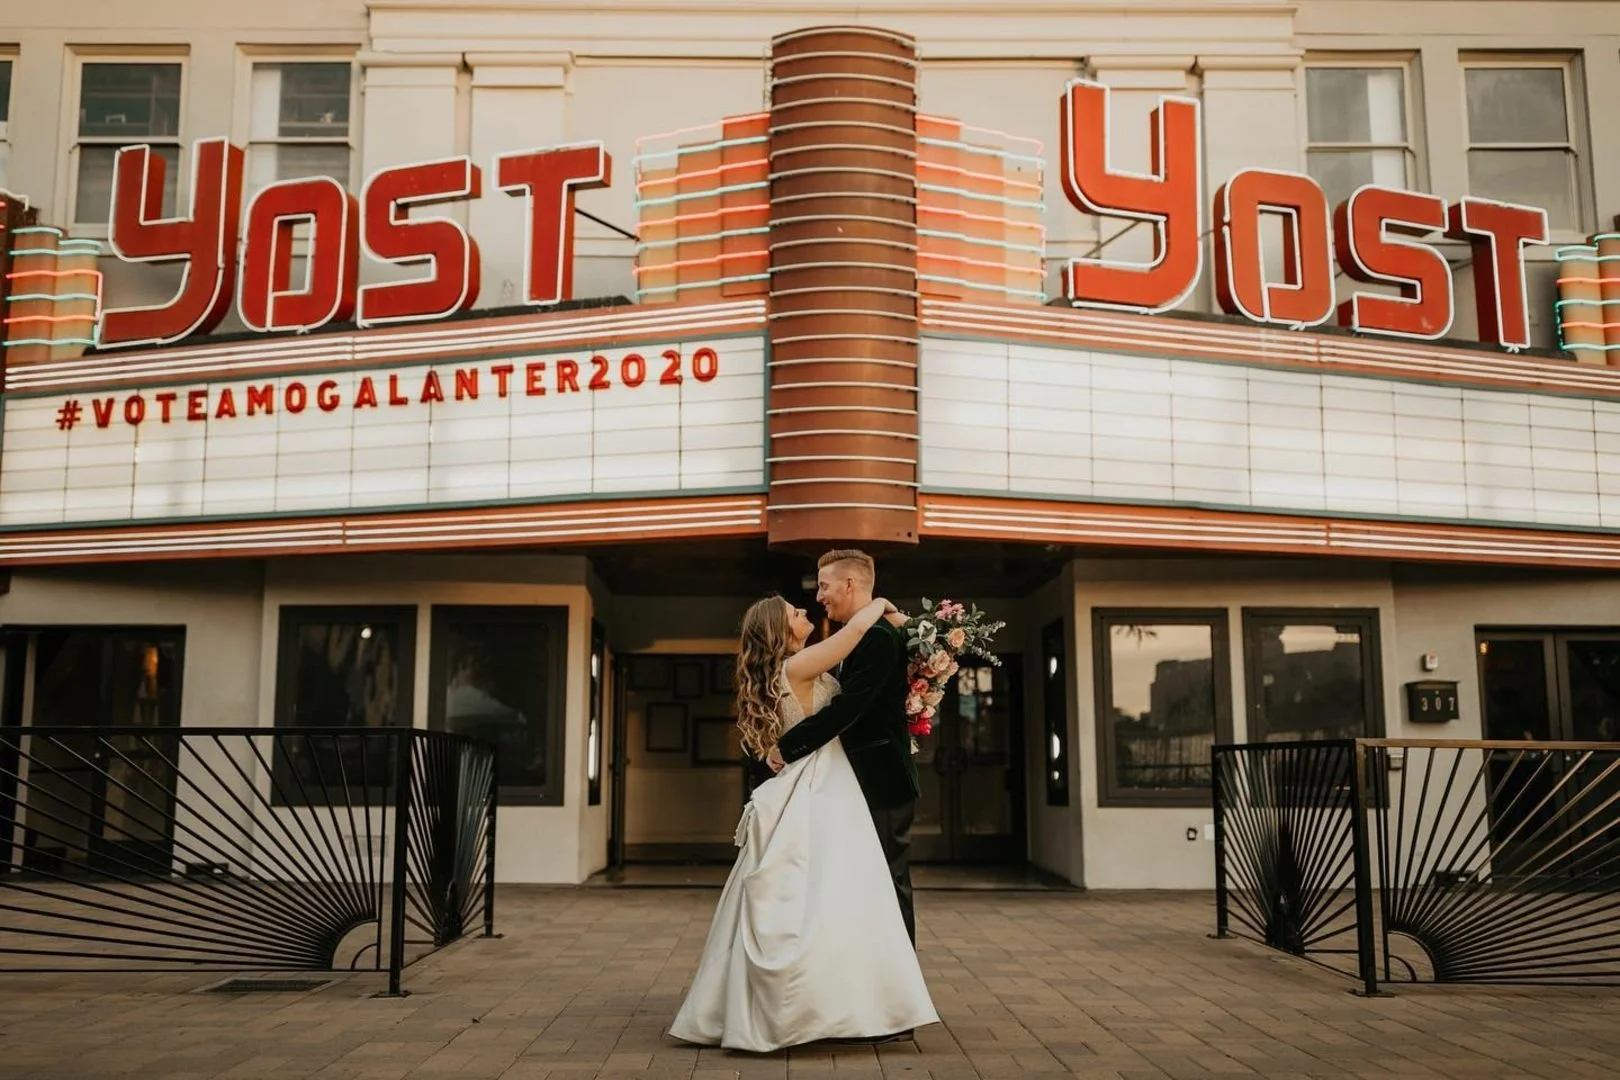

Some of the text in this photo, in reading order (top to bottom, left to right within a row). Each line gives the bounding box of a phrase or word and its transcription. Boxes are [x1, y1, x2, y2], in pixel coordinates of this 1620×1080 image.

[97, 136, 612, 348] YOST
[1060, 78, 1550, 352] YOST
[55, 347, 718, 430] #VOTEAMOGALANTER2020
[1421, 697, 1456, 711] 307
